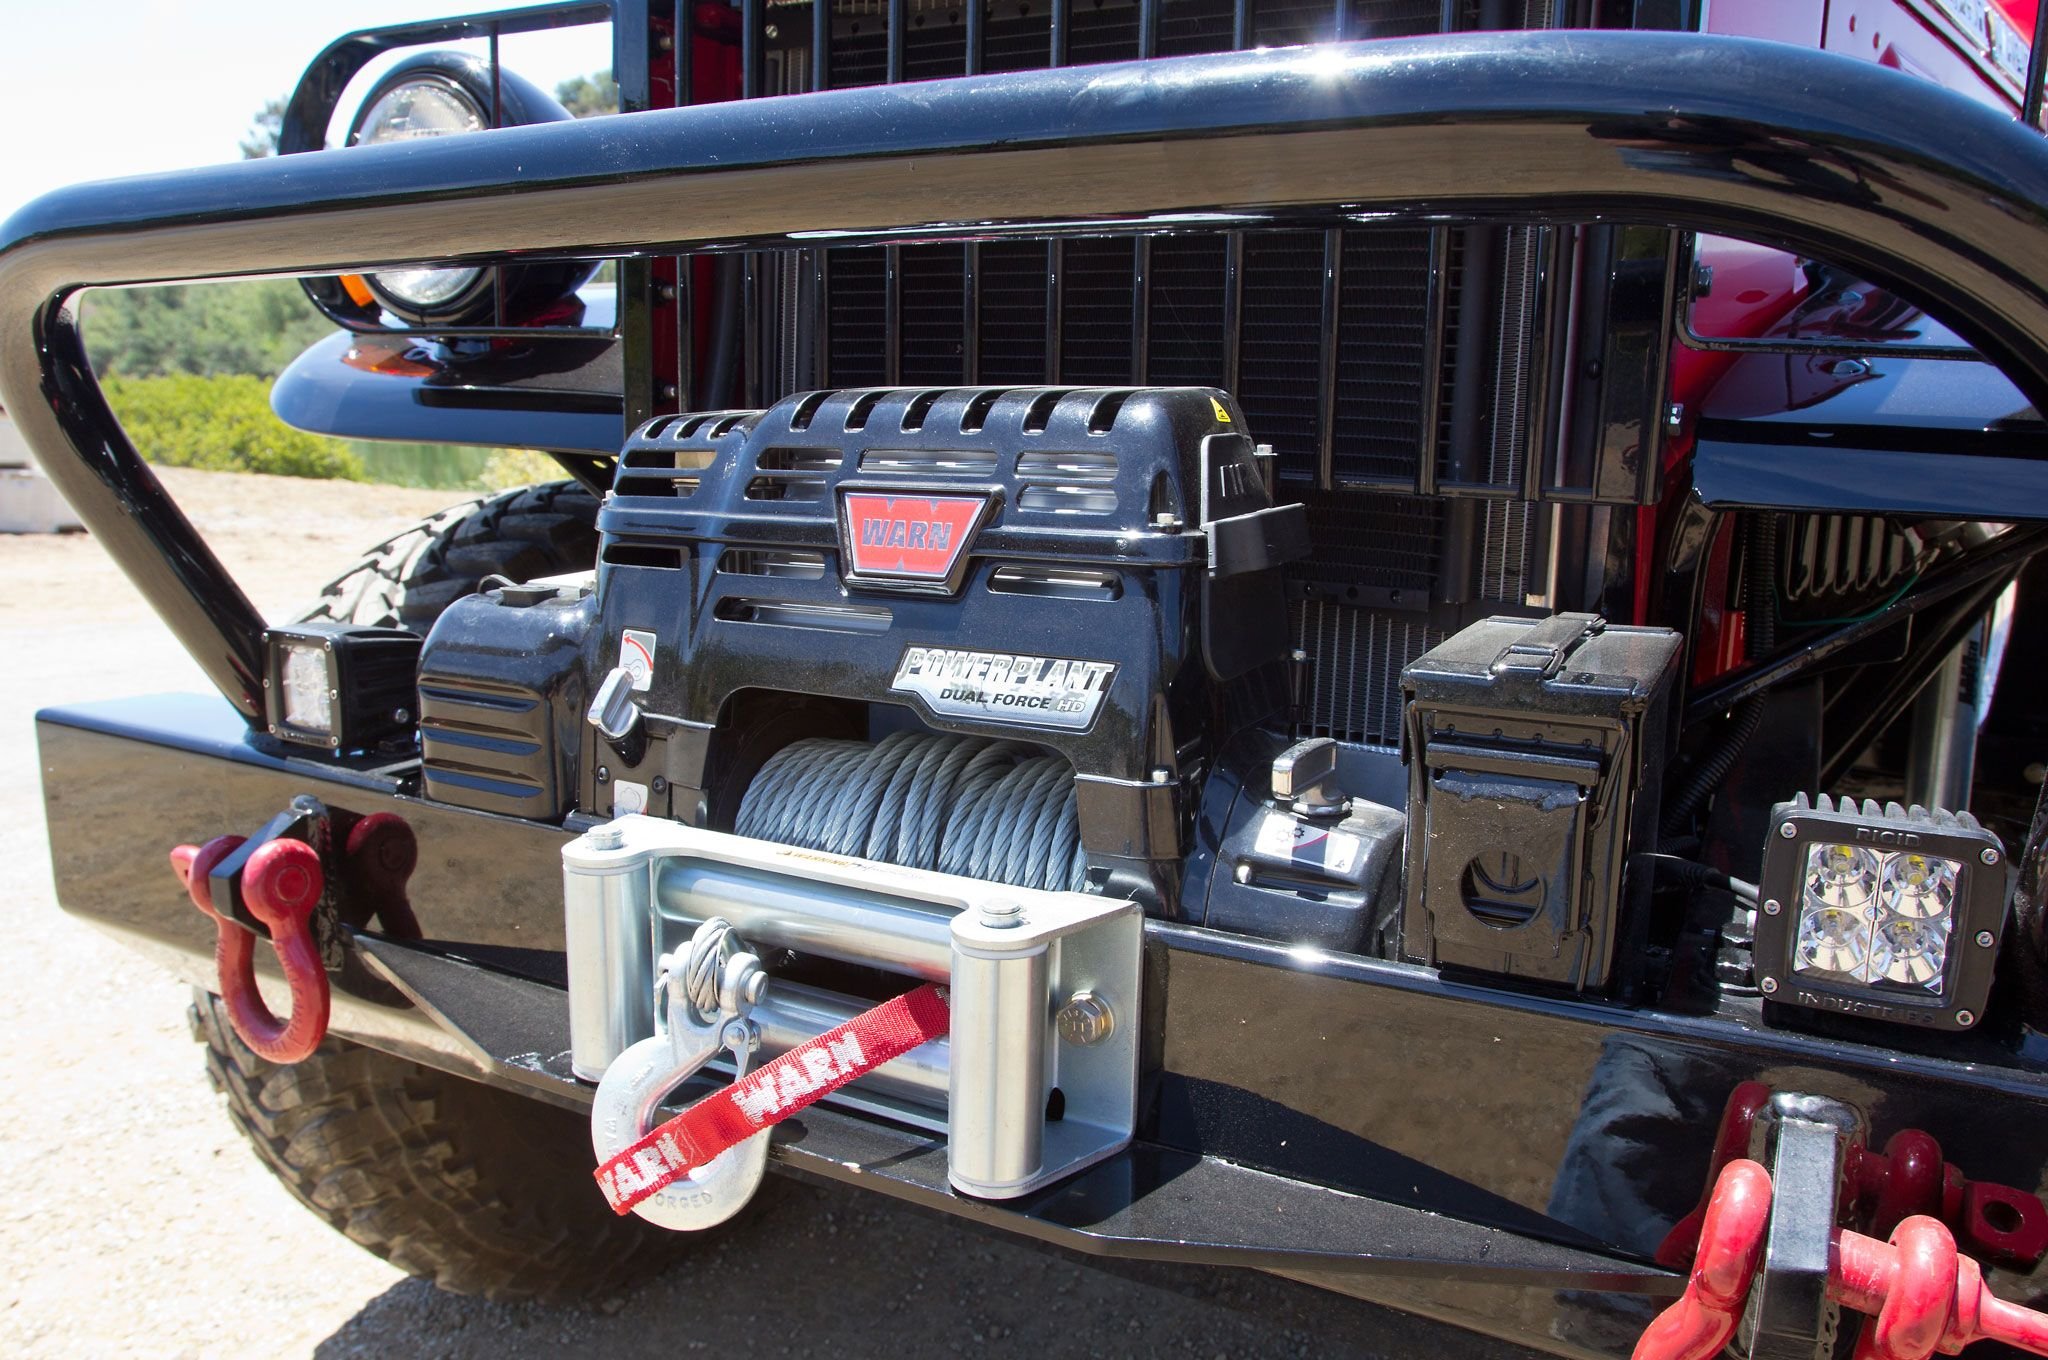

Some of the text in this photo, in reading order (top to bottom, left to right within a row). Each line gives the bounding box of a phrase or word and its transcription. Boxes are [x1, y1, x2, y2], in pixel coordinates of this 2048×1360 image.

[861, 518, 953, 550] WARN
[896, 648, 1116, 693] POWERPLANT
[939, 687, 1087, 714] DUAL FORCE HD
[1855, 827, 1922, 847] RIGID
[730, 1030, 869, 1126] WARN
[654, 1190, 714, 1210] ORGED
